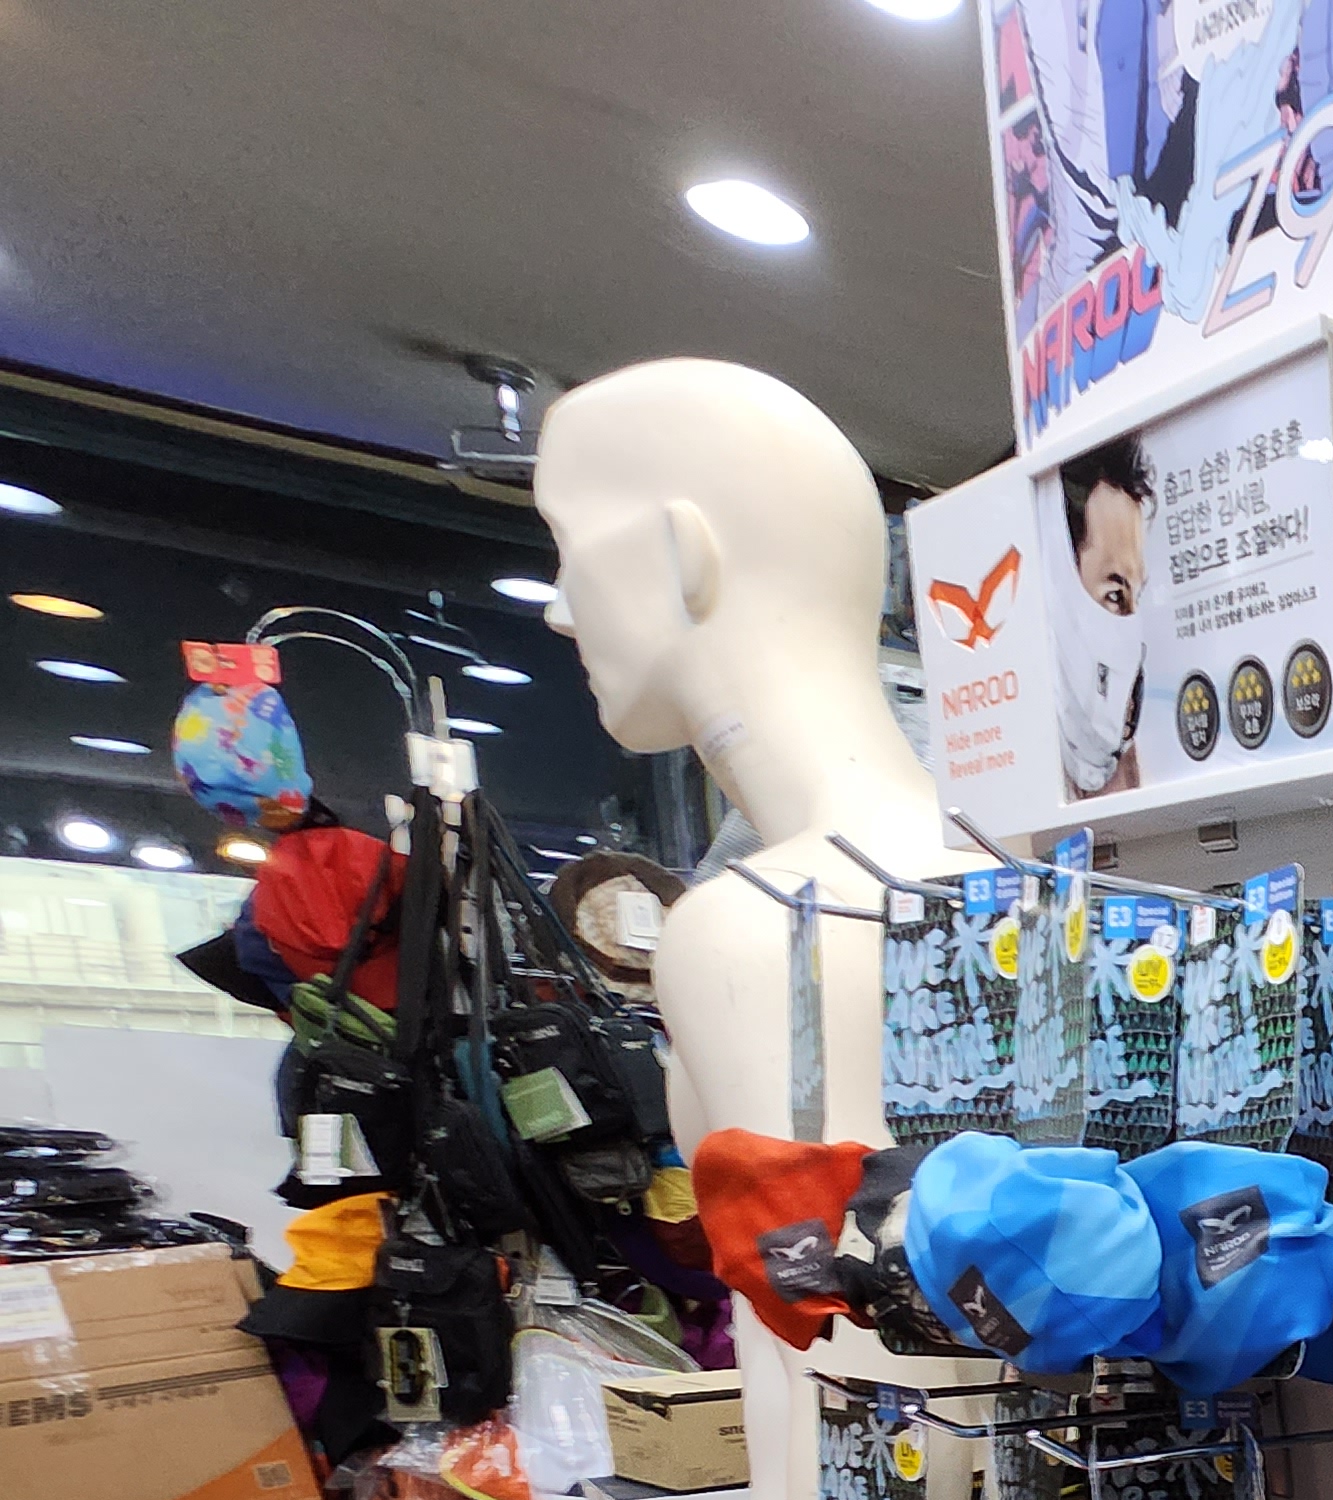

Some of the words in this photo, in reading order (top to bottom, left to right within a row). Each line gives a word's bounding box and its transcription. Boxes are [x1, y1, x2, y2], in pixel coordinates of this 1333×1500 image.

[942, 670, 1019, 720] NAROO
[965, 877, 991, 903] E3
[1108, 905, 1133, 927] E3
[8, 1388, 95, 1427] EMS
[1185, 1401, 1207, 1418] E3
